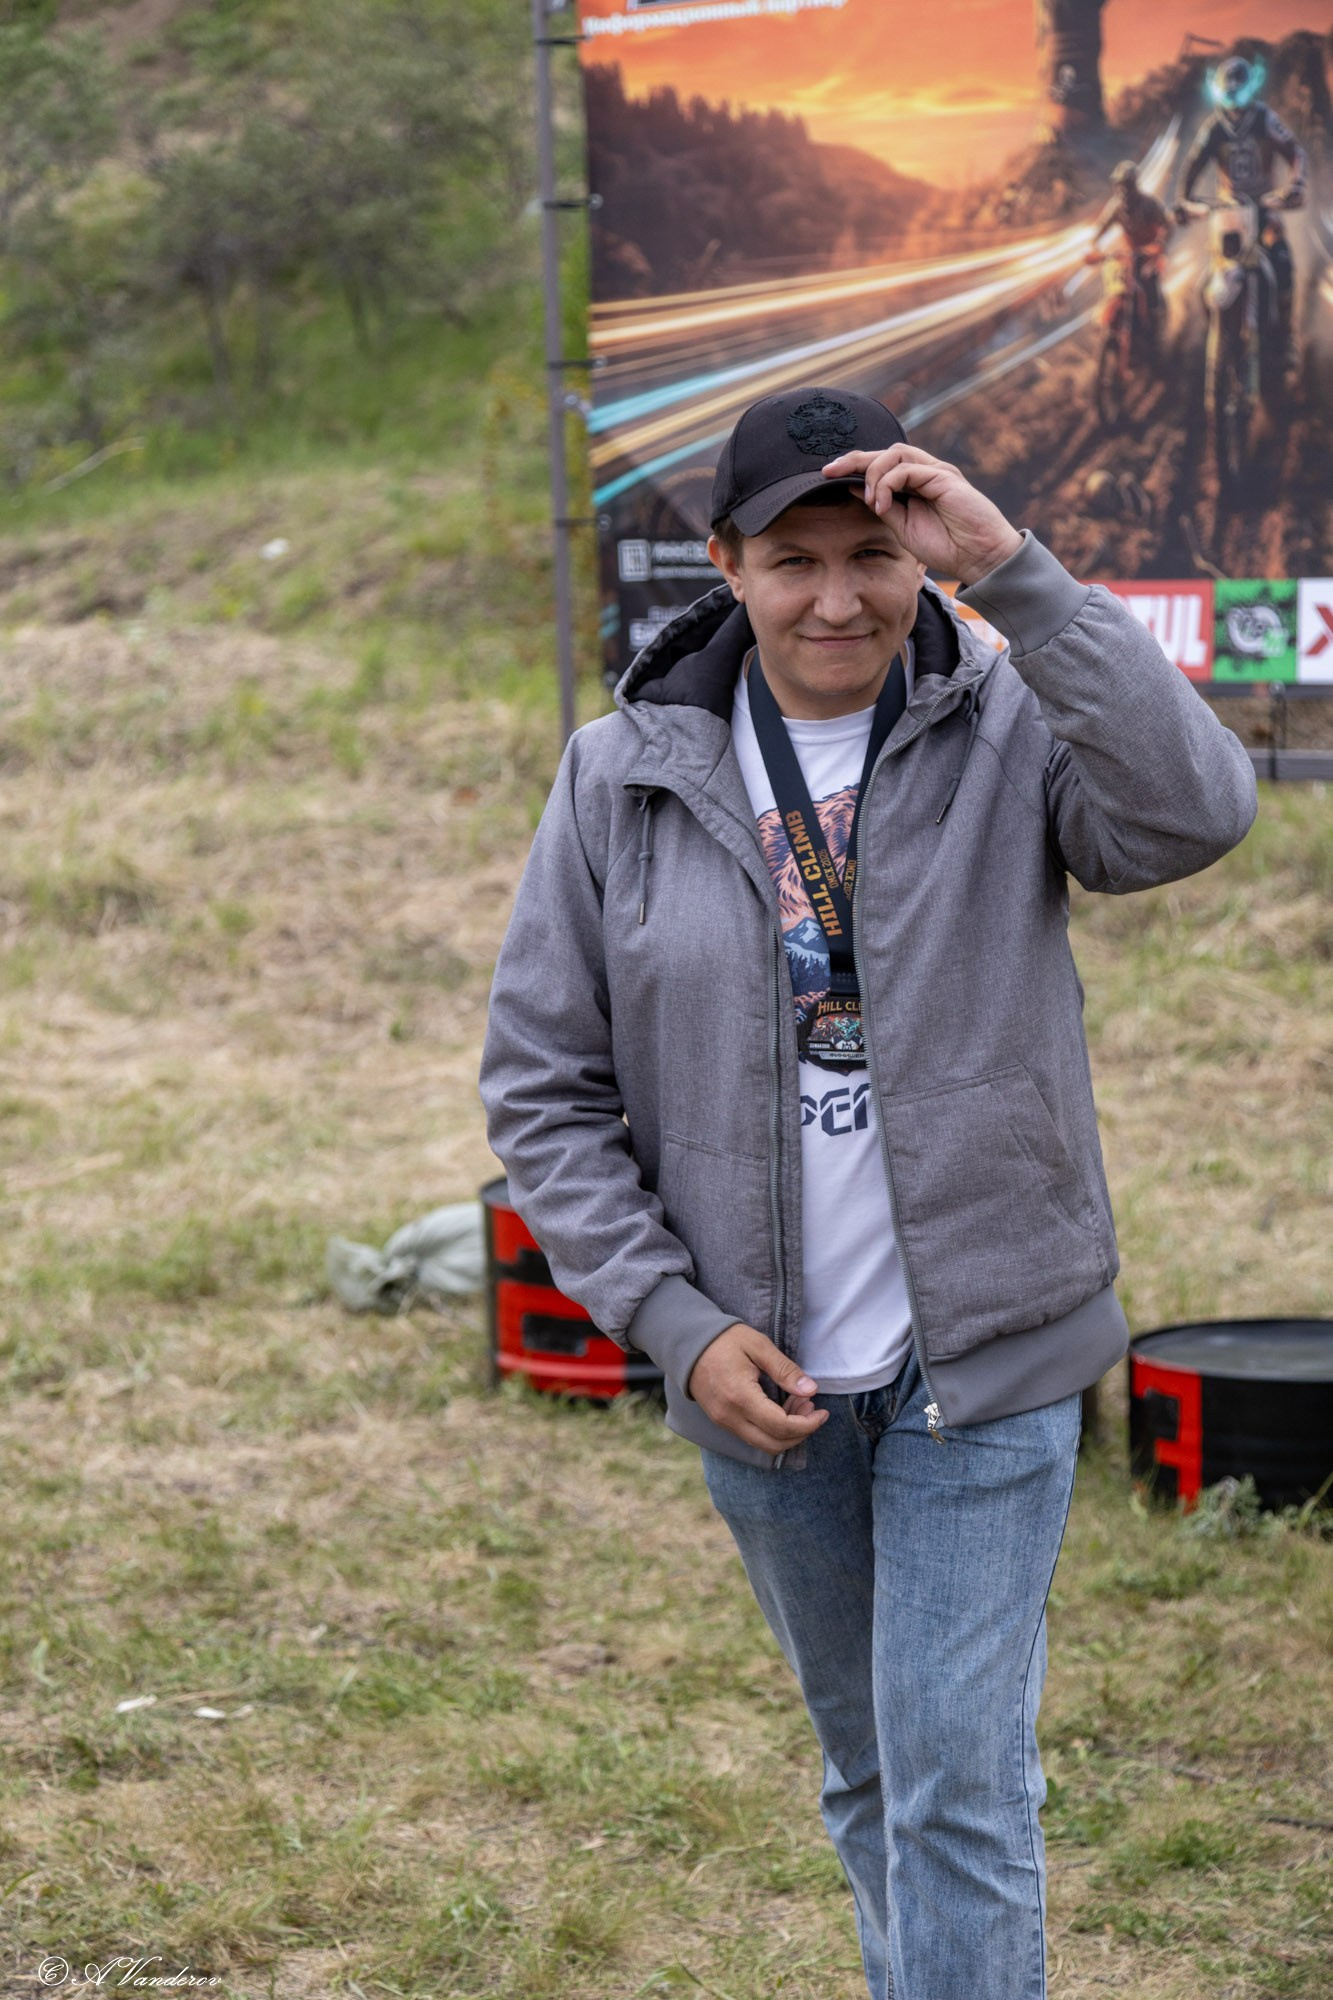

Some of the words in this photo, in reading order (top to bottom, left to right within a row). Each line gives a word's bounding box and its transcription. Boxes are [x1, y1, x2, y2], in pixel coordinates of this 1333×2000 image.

[785, 809, 823, 881] CLIMB
[812, 883, 843, 937] HILL
[817, 1001, 843, 1016] HILL
